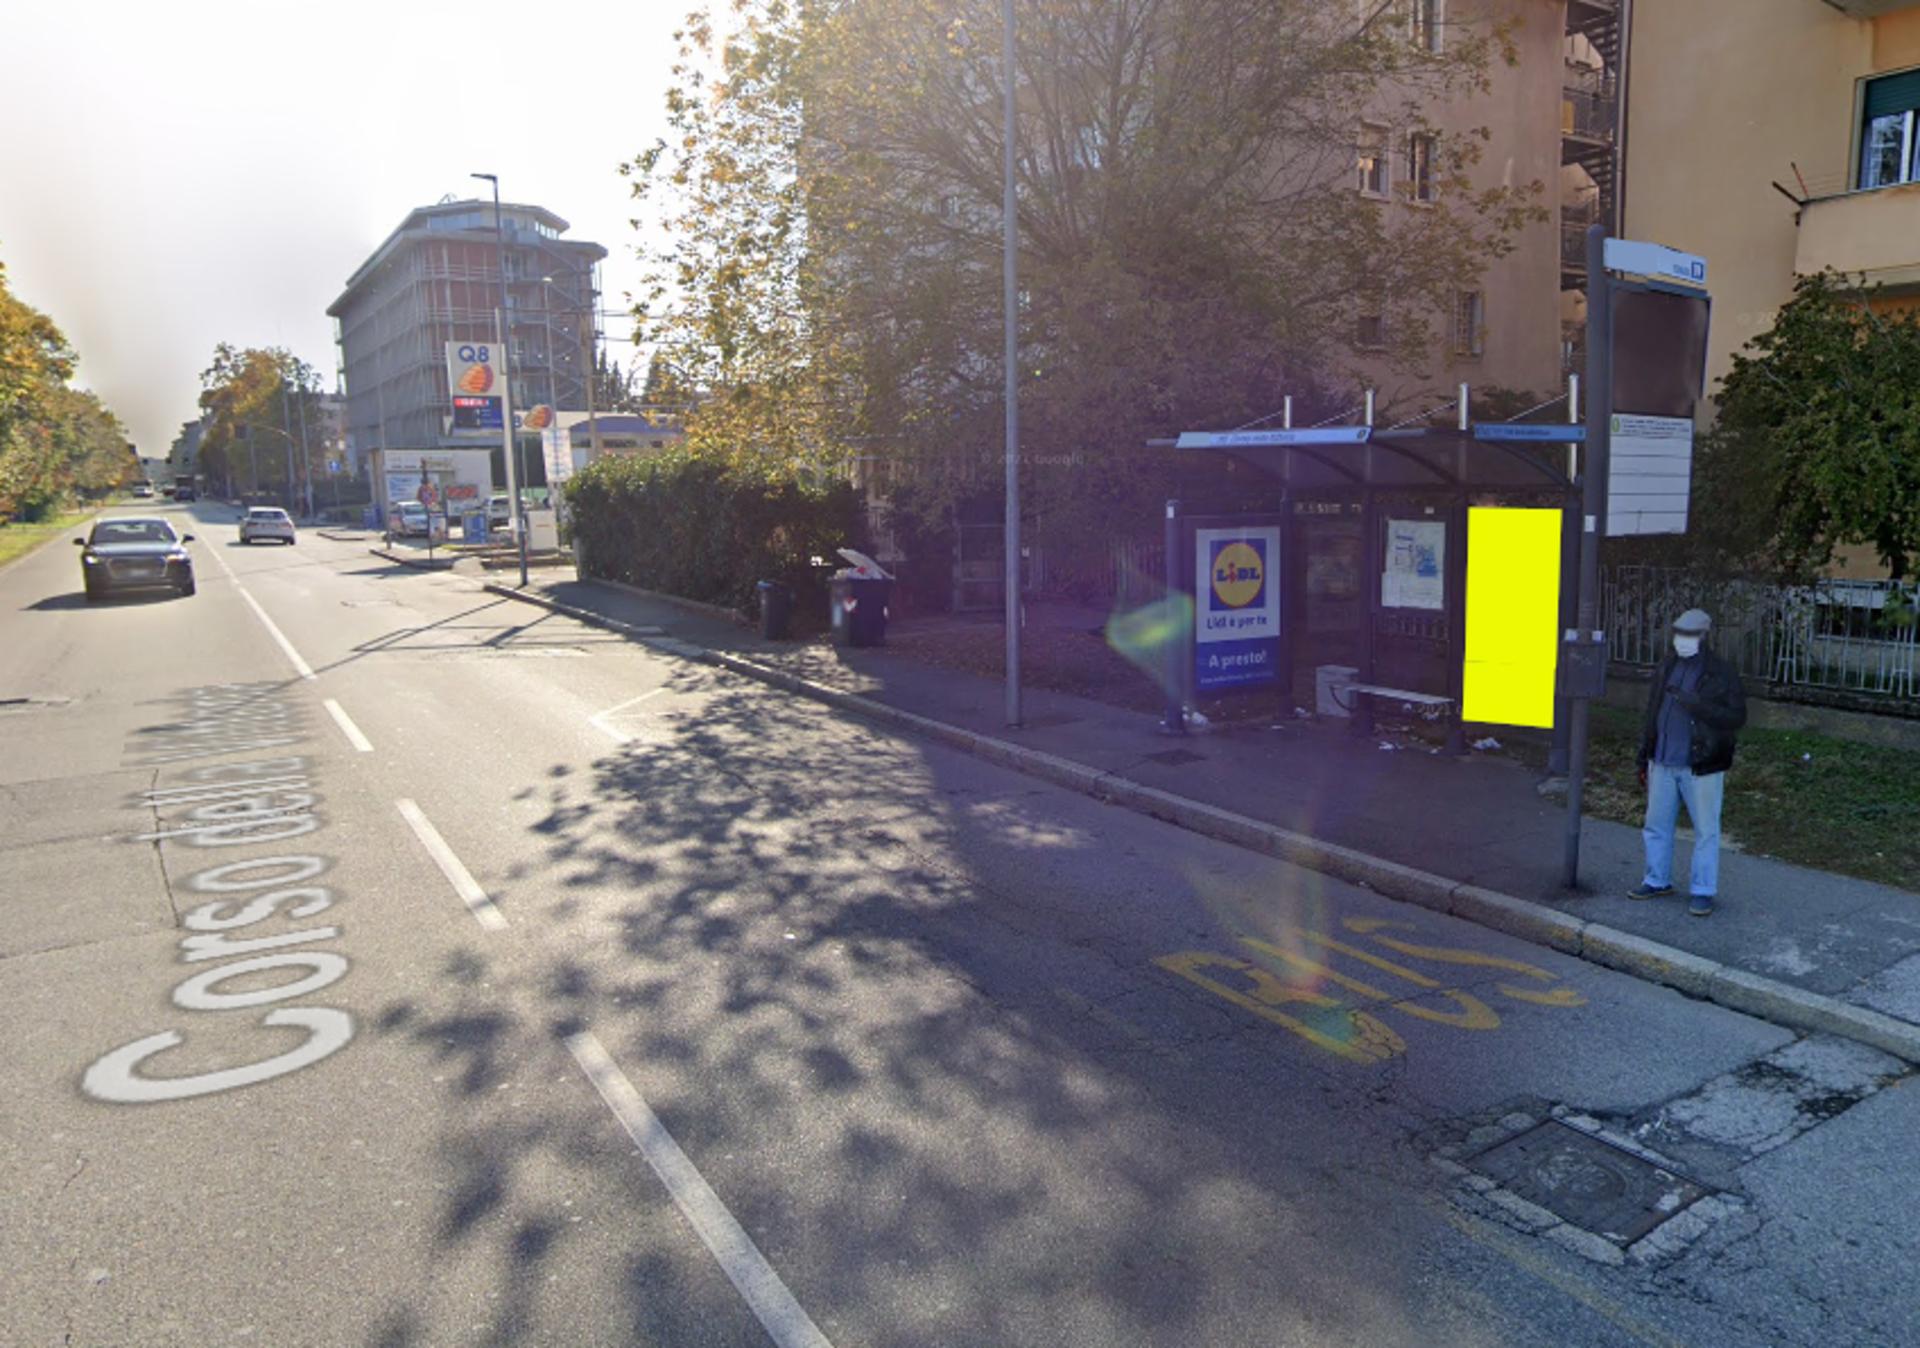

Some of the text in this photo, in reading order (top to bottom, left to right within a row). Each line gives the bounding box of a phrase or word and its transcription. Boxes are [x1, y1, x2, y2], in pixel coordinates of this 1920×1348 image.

[458, 345, 490, 363] Q8
[1207, 616, 1227, 630] Lidl
[1208, 650, 1268, 670] A presto!
[1153, 915, 1588, 1065] BUS
